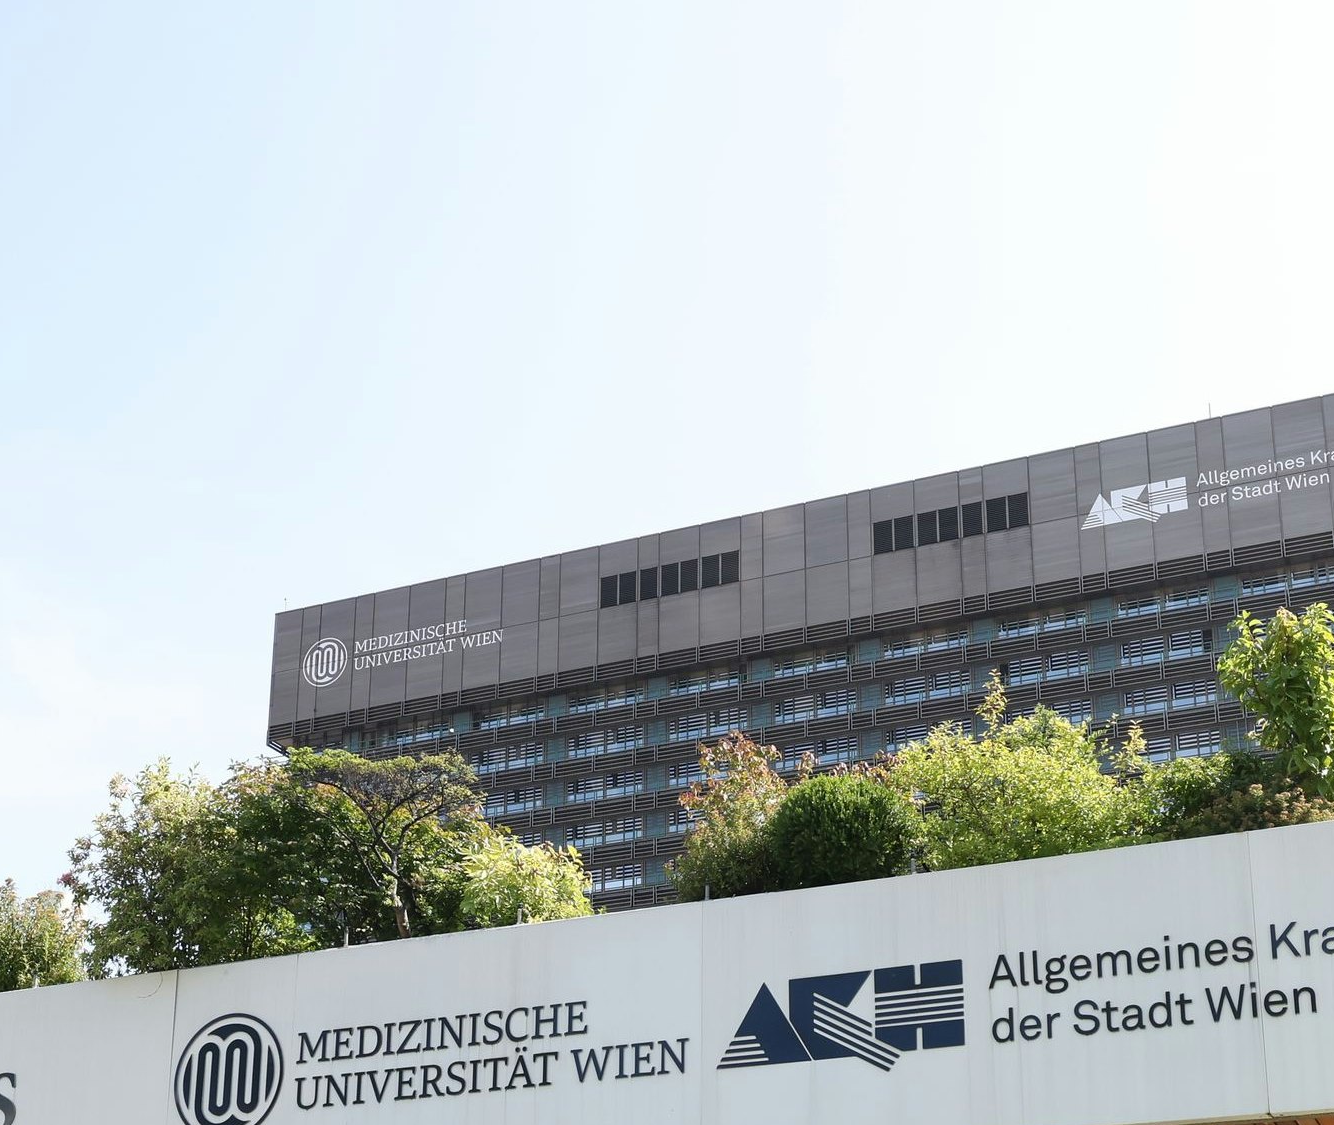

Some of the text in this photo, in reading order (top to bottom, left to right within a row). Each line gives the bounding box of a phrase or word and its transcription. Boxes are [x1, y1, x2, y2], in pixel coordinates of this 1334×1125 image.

[1196, 456, 1305, 487] Allgemeines
[1197, 471, 1330, 508] der Stadt Wien
[354, 619, 467, 654] MEDIZINISCHE
[354, 629, 504, 671] UNIVERSITÄT WIEN
[988, 934, 1255, 994] Allgemeines
[295, 1000, 589, 1065] MEDIZINISCHE
[990, 981, 1318, 1044] der Stadt Wien
[294, 1037, 690, 1111] UNIVERSITÄT WIEN
